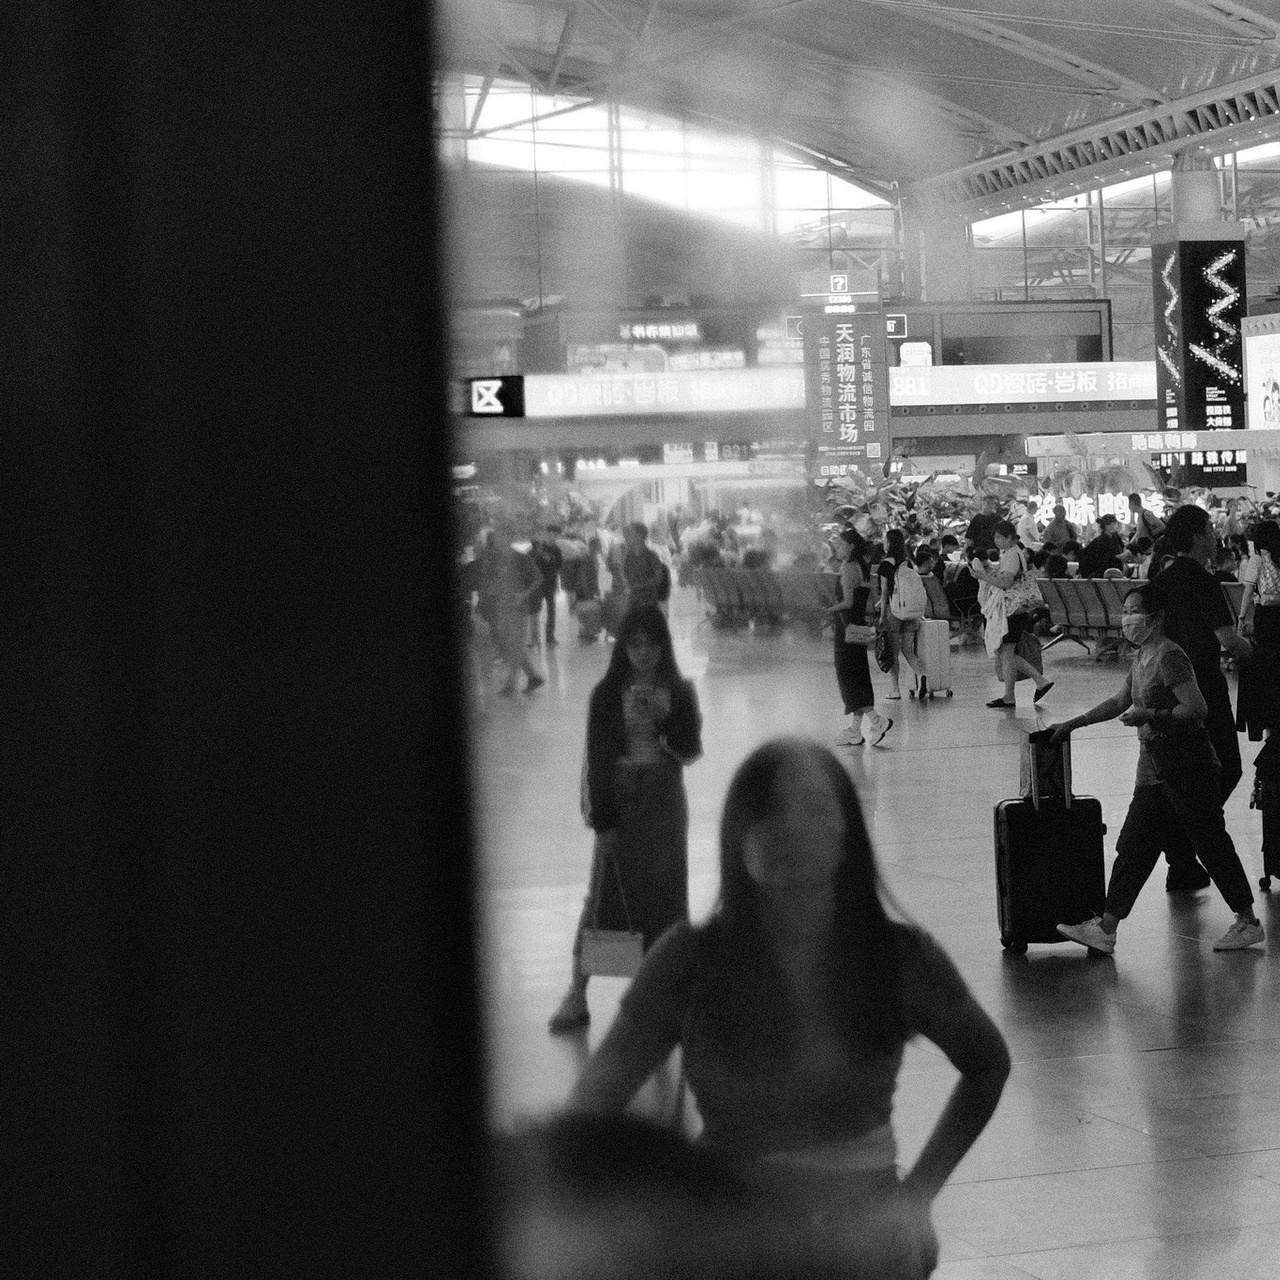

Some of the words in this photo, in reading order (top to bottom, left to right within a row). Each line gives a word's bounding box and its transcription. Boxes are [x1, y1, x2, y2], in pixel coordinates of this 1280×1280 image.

[836, 323, 859, 443] 天润物流市场
